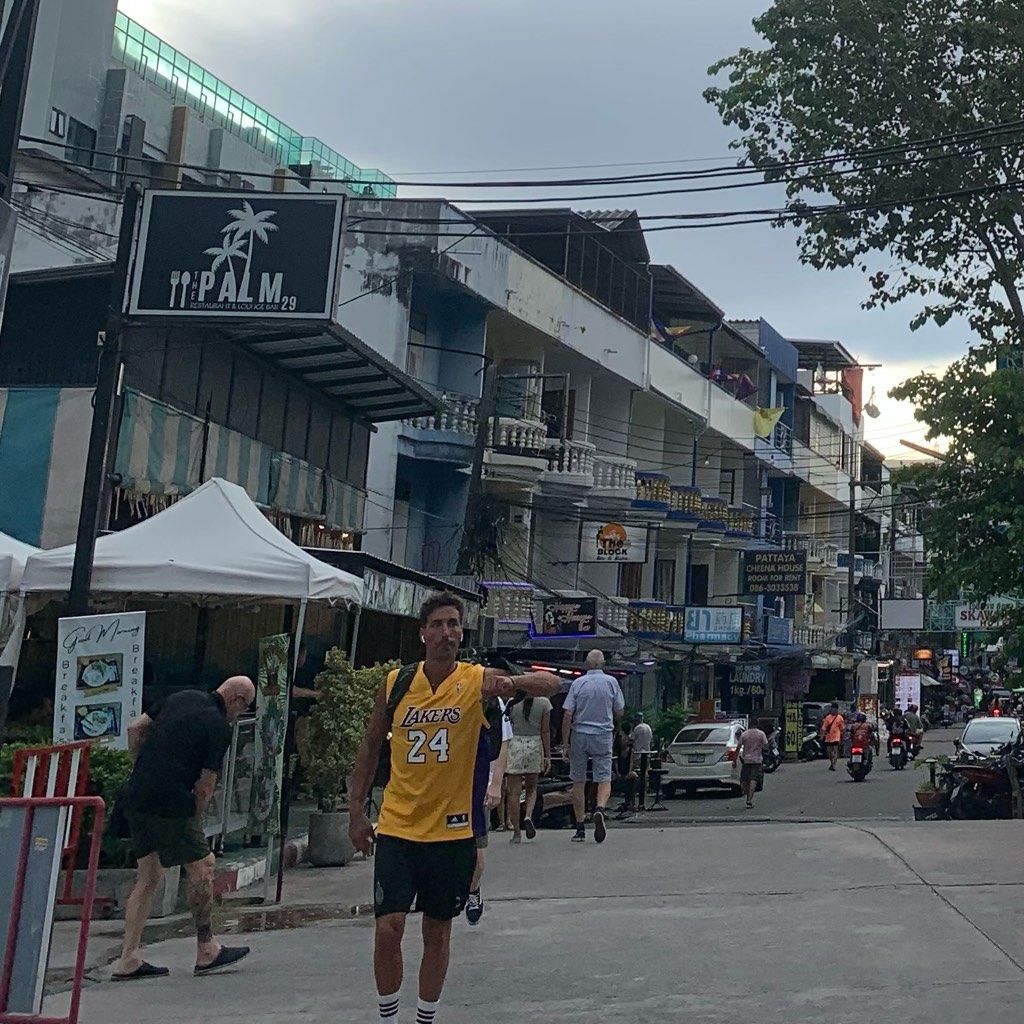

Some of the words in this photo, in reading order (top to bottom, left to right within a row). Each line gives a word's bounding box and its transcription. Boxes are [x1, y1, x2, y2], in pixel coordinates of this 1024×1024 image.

[190, 271, 199, 301] THE
[198, 270, 284, 304] PALM
[281, 295, 297, 311] 29
[597, 548, 628, 556] BLOCK
[755, 553, 796, 563] PATTAYA
[747, 574, 769, 582] ROOM
[770, 574, 783, 582] FOR
[784, 574, 801, 582] RENT
[777, 563, 804, 572] HOUSE
[63, 626, 93, 654] Good
[96, 619, 141, 643] Morning
[686, 631, 740, 641] Pharmacy
[129, 644, 140, 718] Breakfa
[729, 671, 766, 683] LAUNDRY
[57, 660, 70, 743] Breakfas
[400, 706, 461, 727] LAKERS
[406, 728, 450, 764] 24
